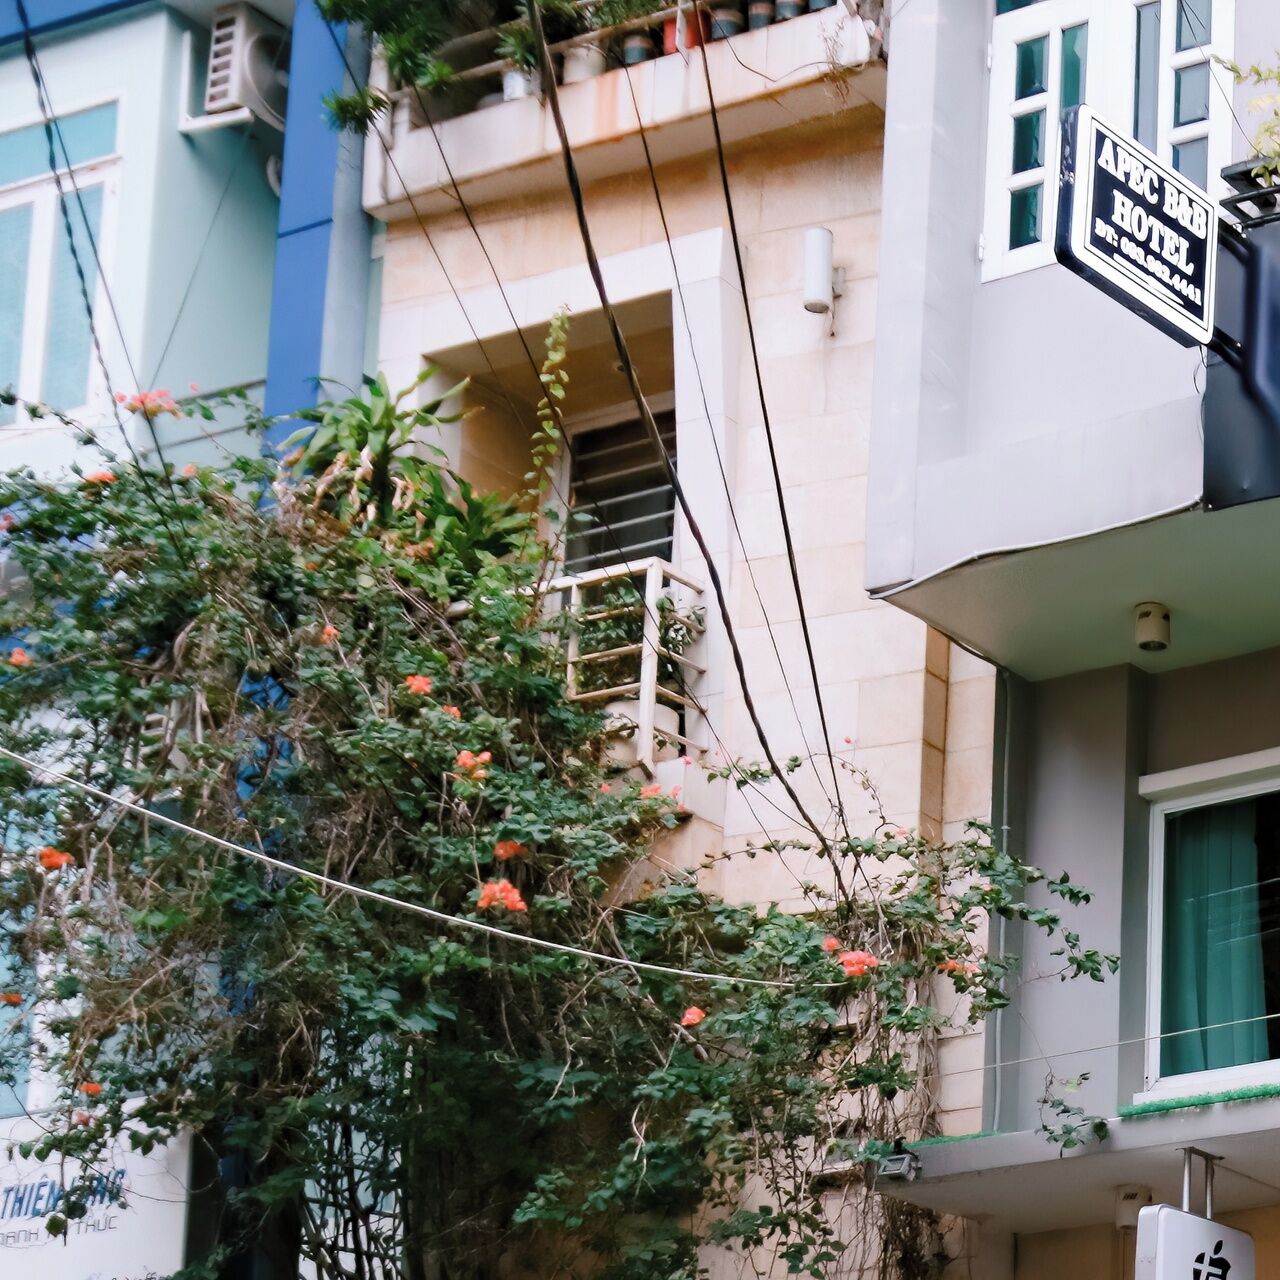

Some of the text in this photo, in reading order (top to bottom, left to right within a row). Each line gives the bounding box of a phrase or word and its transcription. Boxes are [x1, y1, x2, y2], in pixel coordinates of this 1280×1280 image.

[1097, 136, 1208, 240] APEC B&B
[1111, 188, 1195, 277] HOTEL
